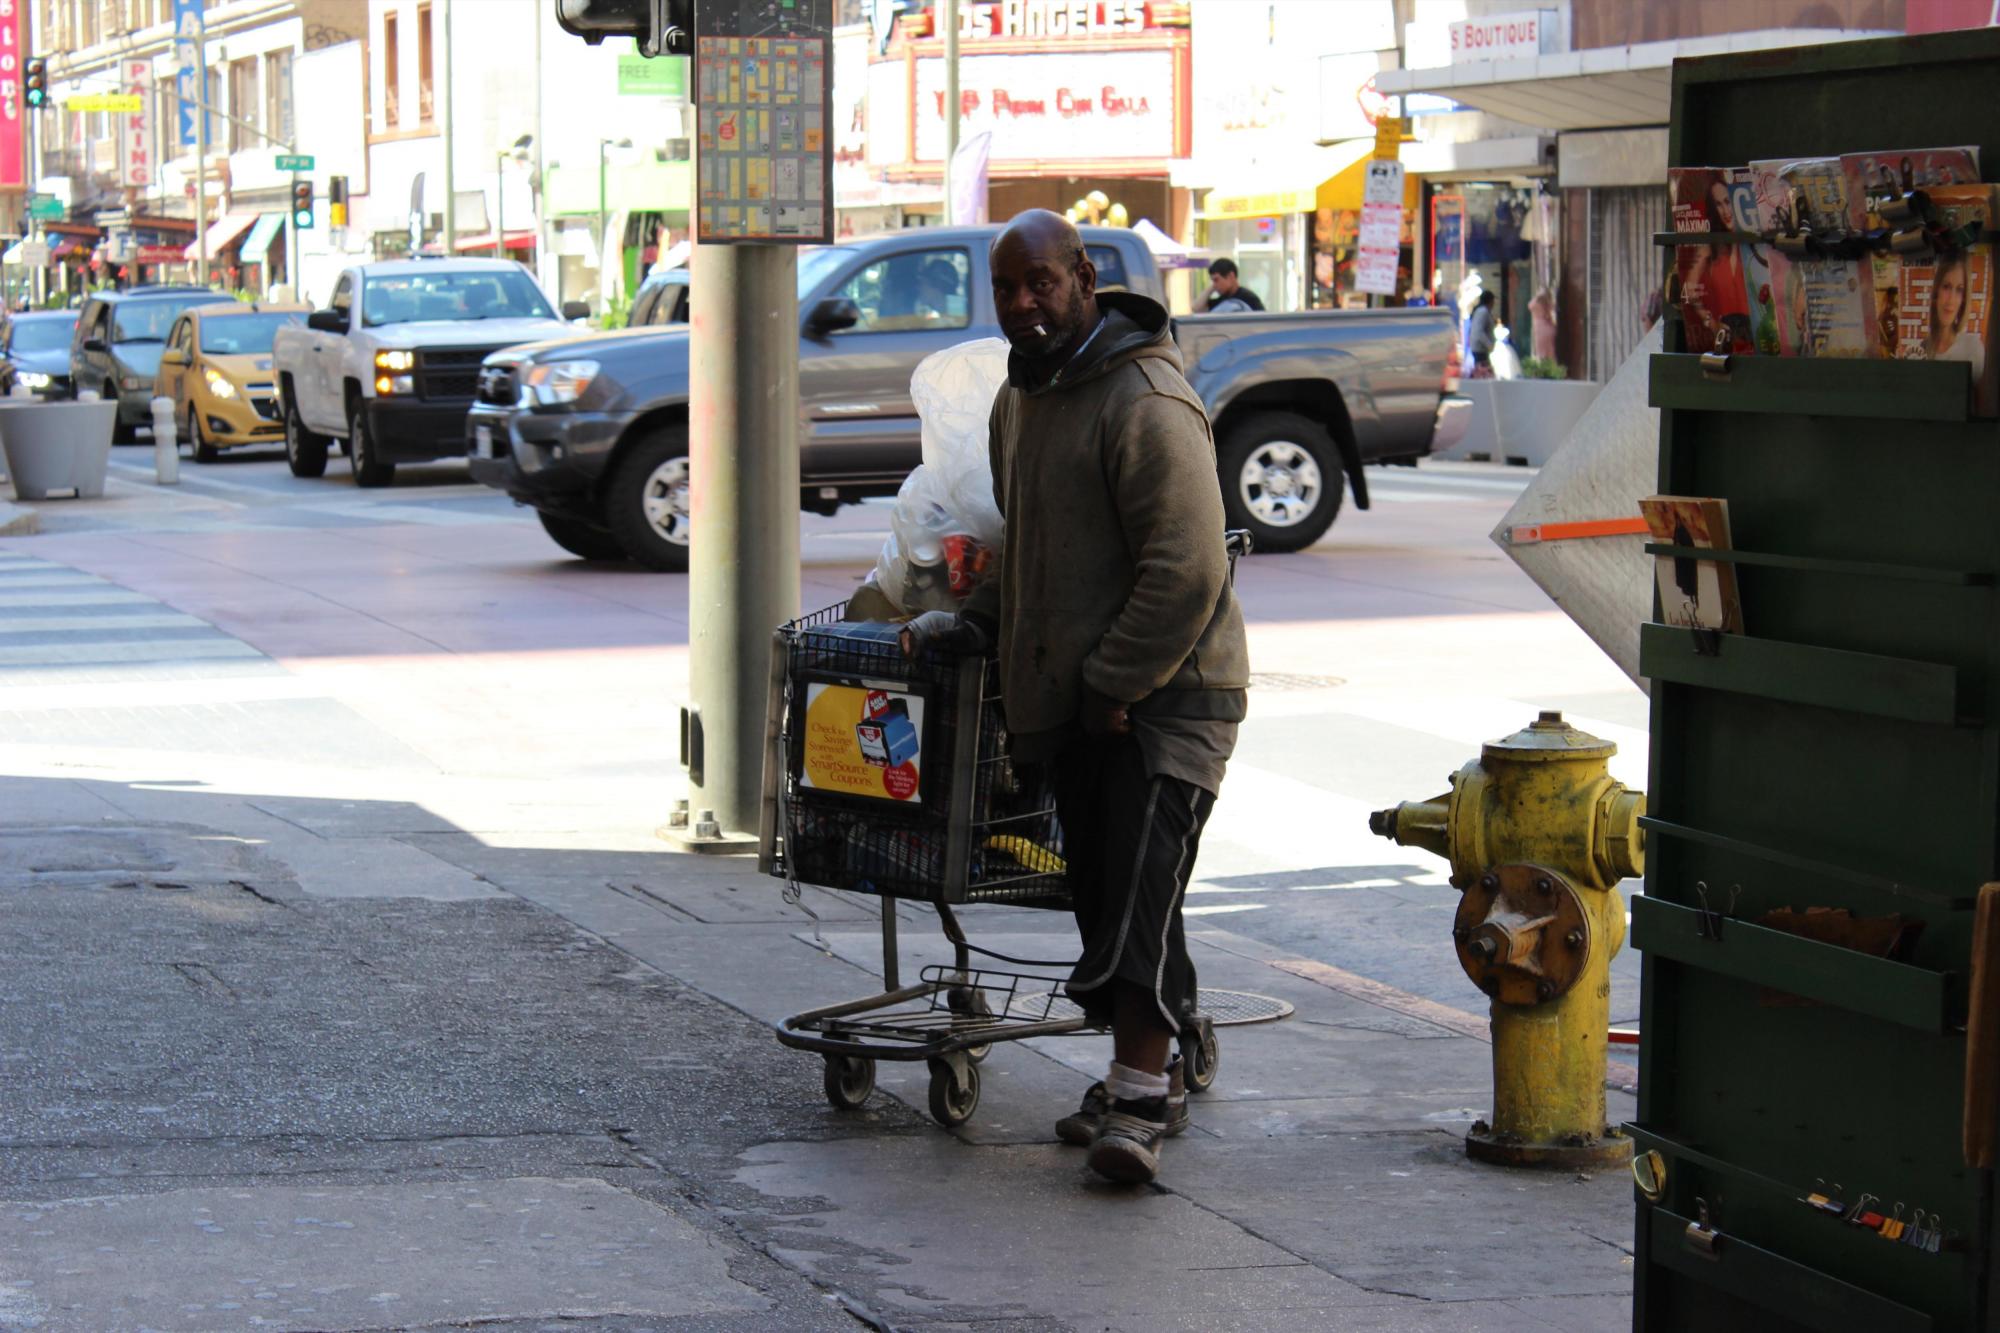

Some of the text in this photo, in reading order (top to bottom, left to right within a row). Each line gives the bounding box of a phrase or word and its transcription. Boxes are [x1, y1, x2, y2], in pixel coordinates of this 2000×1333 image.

[935, 0, 1143, 37] LOS ANGELES
[1464, 19, 1537, 49] BOUTIQUE
[619, 65, 650, 79] FREE
[830, 770, 873, 787] Coupons
